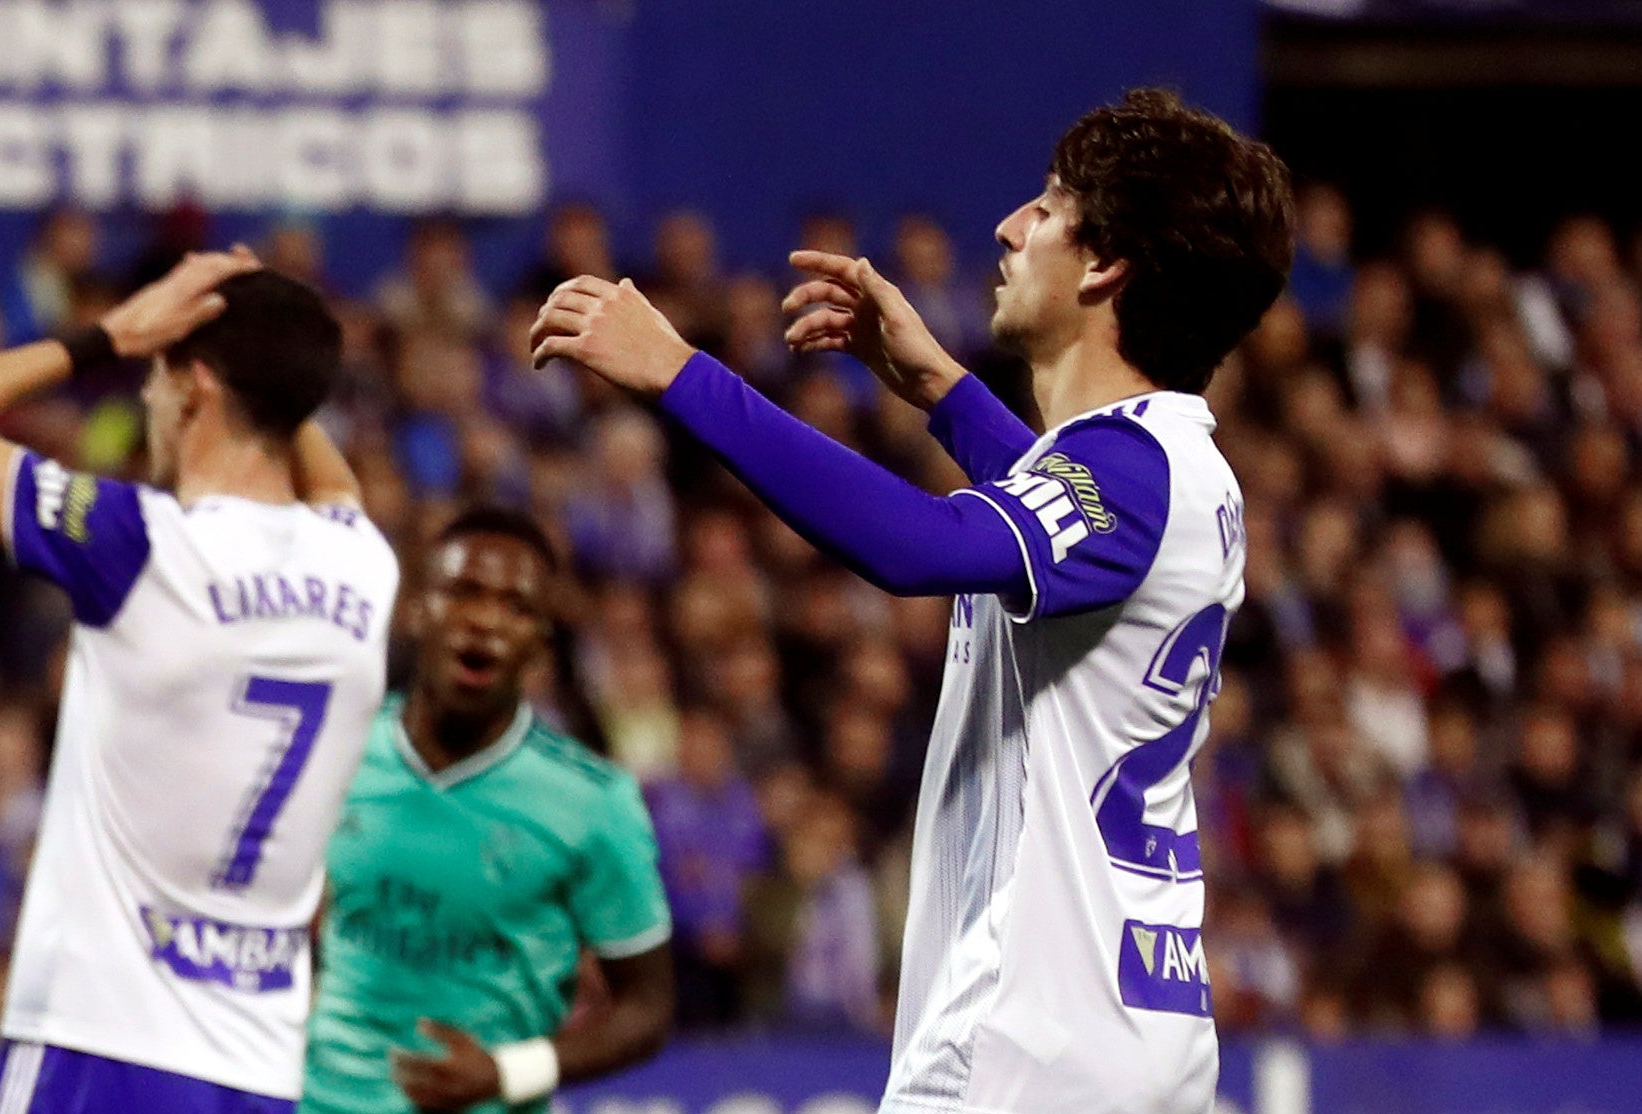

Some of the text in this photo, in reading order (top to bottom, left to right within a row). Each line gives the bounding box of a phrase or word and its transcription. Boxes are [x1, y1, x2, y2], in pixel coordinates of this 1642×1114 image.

[208, 573, 373, 641] LINARES
[209, 675, 332, 890] 7
[1091, 602, 1223, 882] 2
